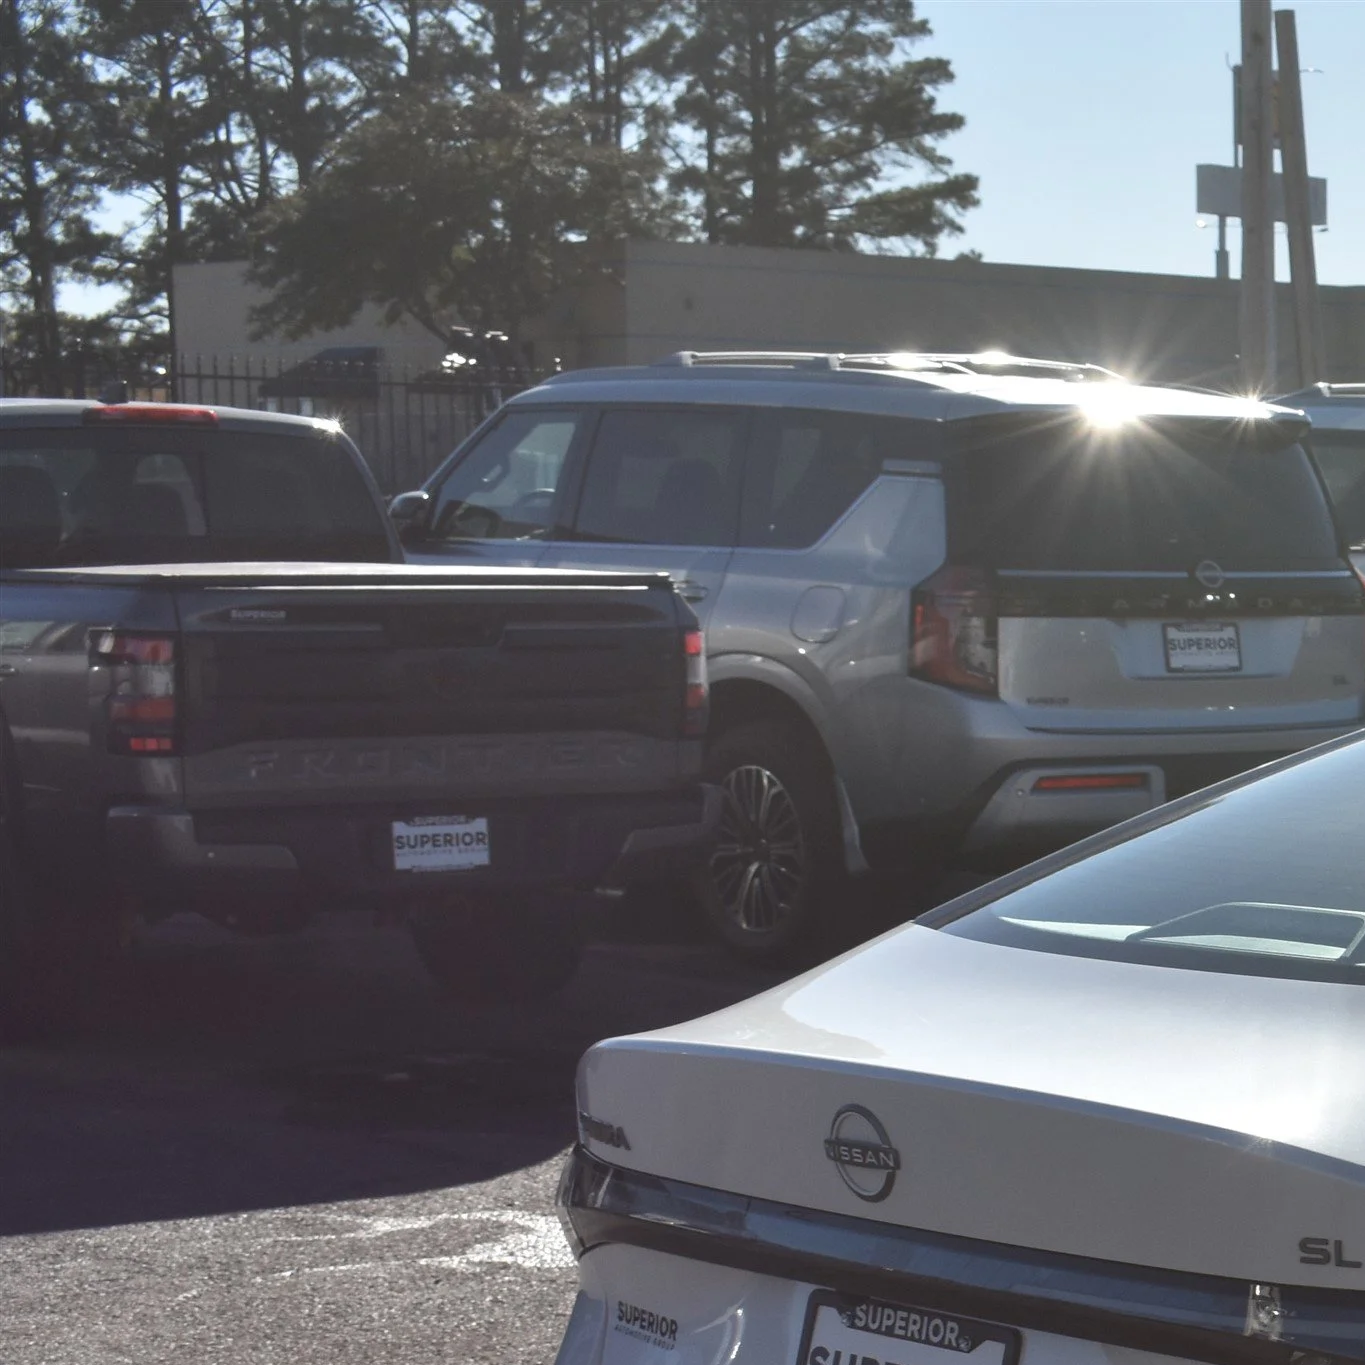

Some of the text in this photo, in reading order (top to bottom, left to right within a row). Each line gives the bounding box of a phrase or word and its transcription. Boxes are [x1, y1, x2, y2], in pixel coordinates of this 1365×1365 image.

[1168, 636, 1237, 651] SUPERIOR
[395, 831, 487, 849] SUPERIOR
[1299, 1236, 1363, 1269] SL
[617, 1300, 678, 1342] SUPERIOR
[854, 1303, 960, 1348] SUPERIOR
